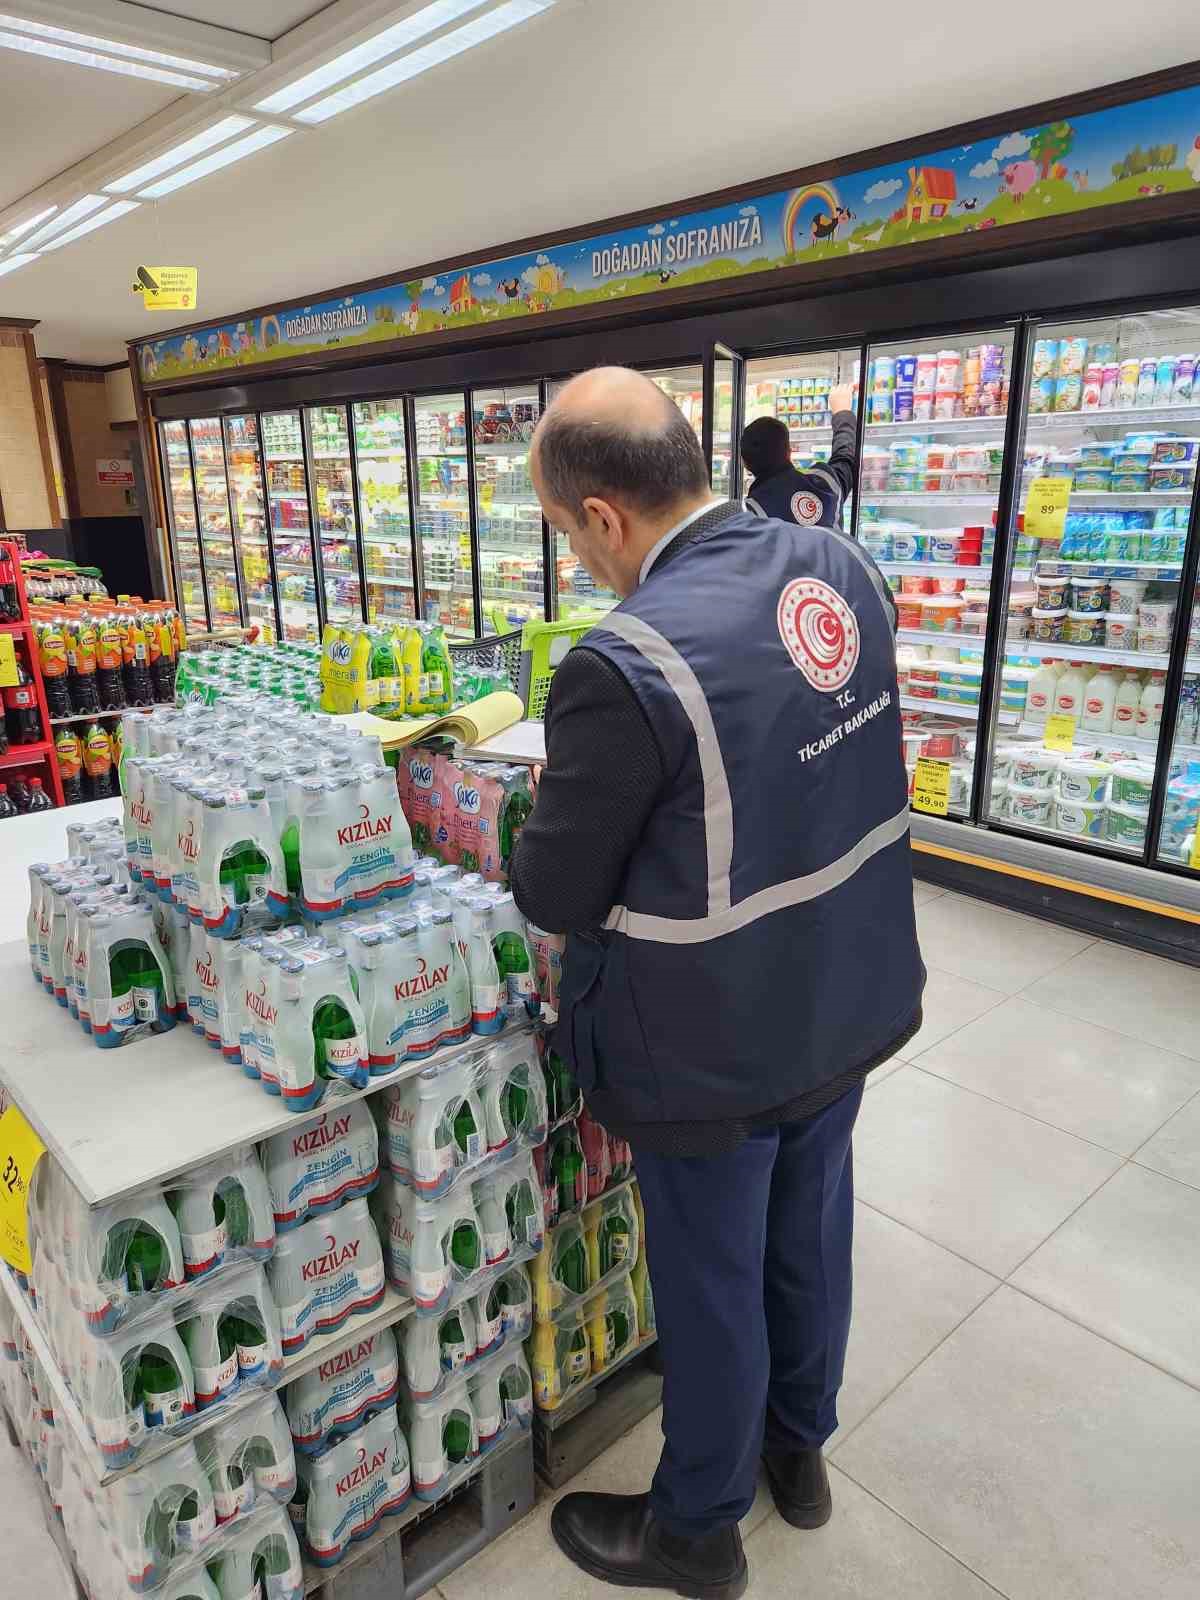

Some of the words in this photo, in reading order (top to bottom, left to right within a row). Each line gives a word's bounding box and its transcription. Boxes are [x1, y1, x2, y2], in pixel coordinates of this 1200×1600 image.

[591, 238, 662, 278] DOĞADAN
[666, 215, 762, 262] SOFRANIZA
[286, 313, 321, 337] DOĞADAN
[322, 304, 367, 330] SOFRANIZA
[836, 690, 856, 709] T.C.
[797, 725, 843, 762] TİCARET
[844, 691, 891, 734] BAKANLIĞI
[337, 815, 392, 845] KIZILAY
[394, 965, 449, 1000] KIZILAY
[292, 1115, 351, 1157] KIZILAY
[302, 1240, 360, 1281] KIZILAY
[319, 1336, 374, 1382] KIZILAY
[336, 1447, 387, 1497] KIZILAY
